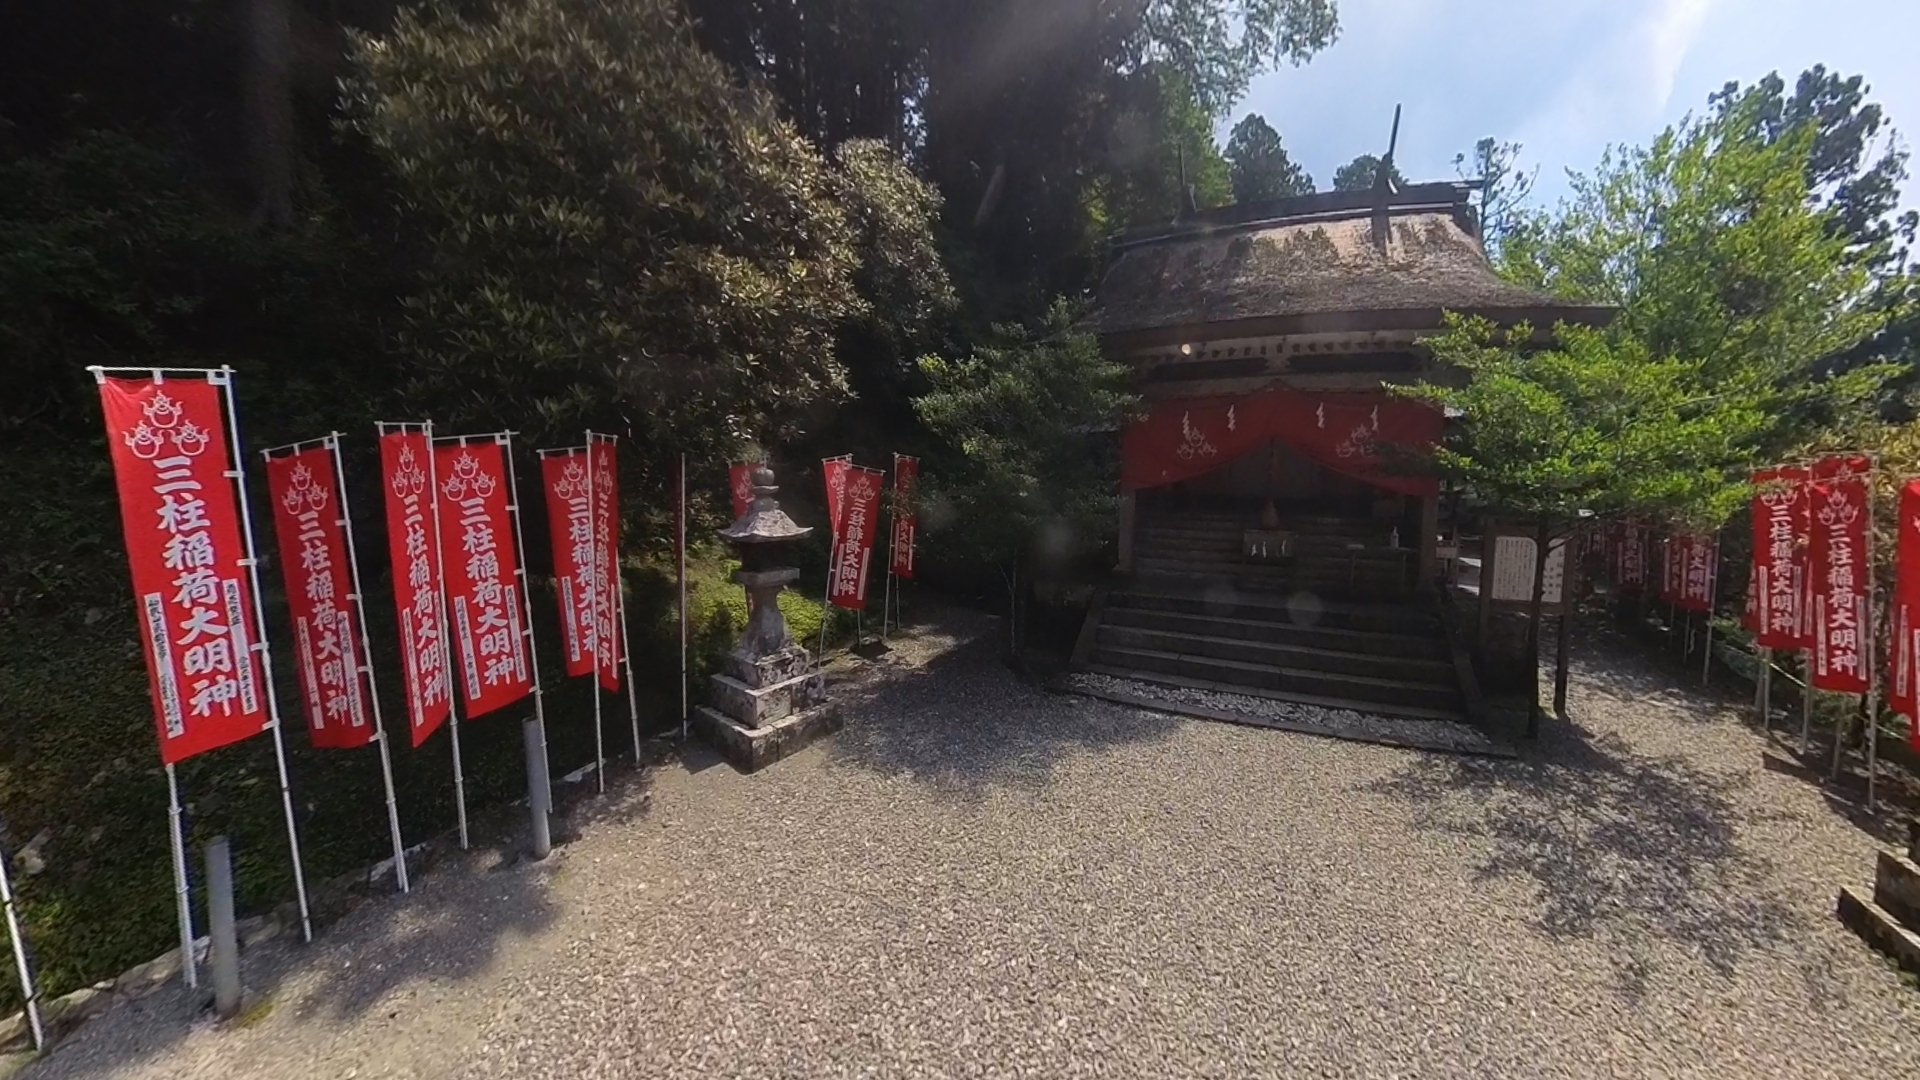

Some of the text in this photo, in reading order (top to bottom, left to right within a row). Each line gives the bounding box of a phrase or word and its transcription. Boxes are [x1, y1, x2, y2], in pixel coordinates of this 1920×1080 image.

[153, 458, 239, 718] 三柱稲荷大明神
[297, 511, 346, 725] 三柱稲荷大明神
[403, 495, 449, 706] 三柱稲荷大明神
[458, 498, 516, 686] 三柱稲荷大明神
[1769, 505, 1794, 634] 三柱稲荷大明神
[1827, 523, 1858, 675] 三柱稲荷大明神
